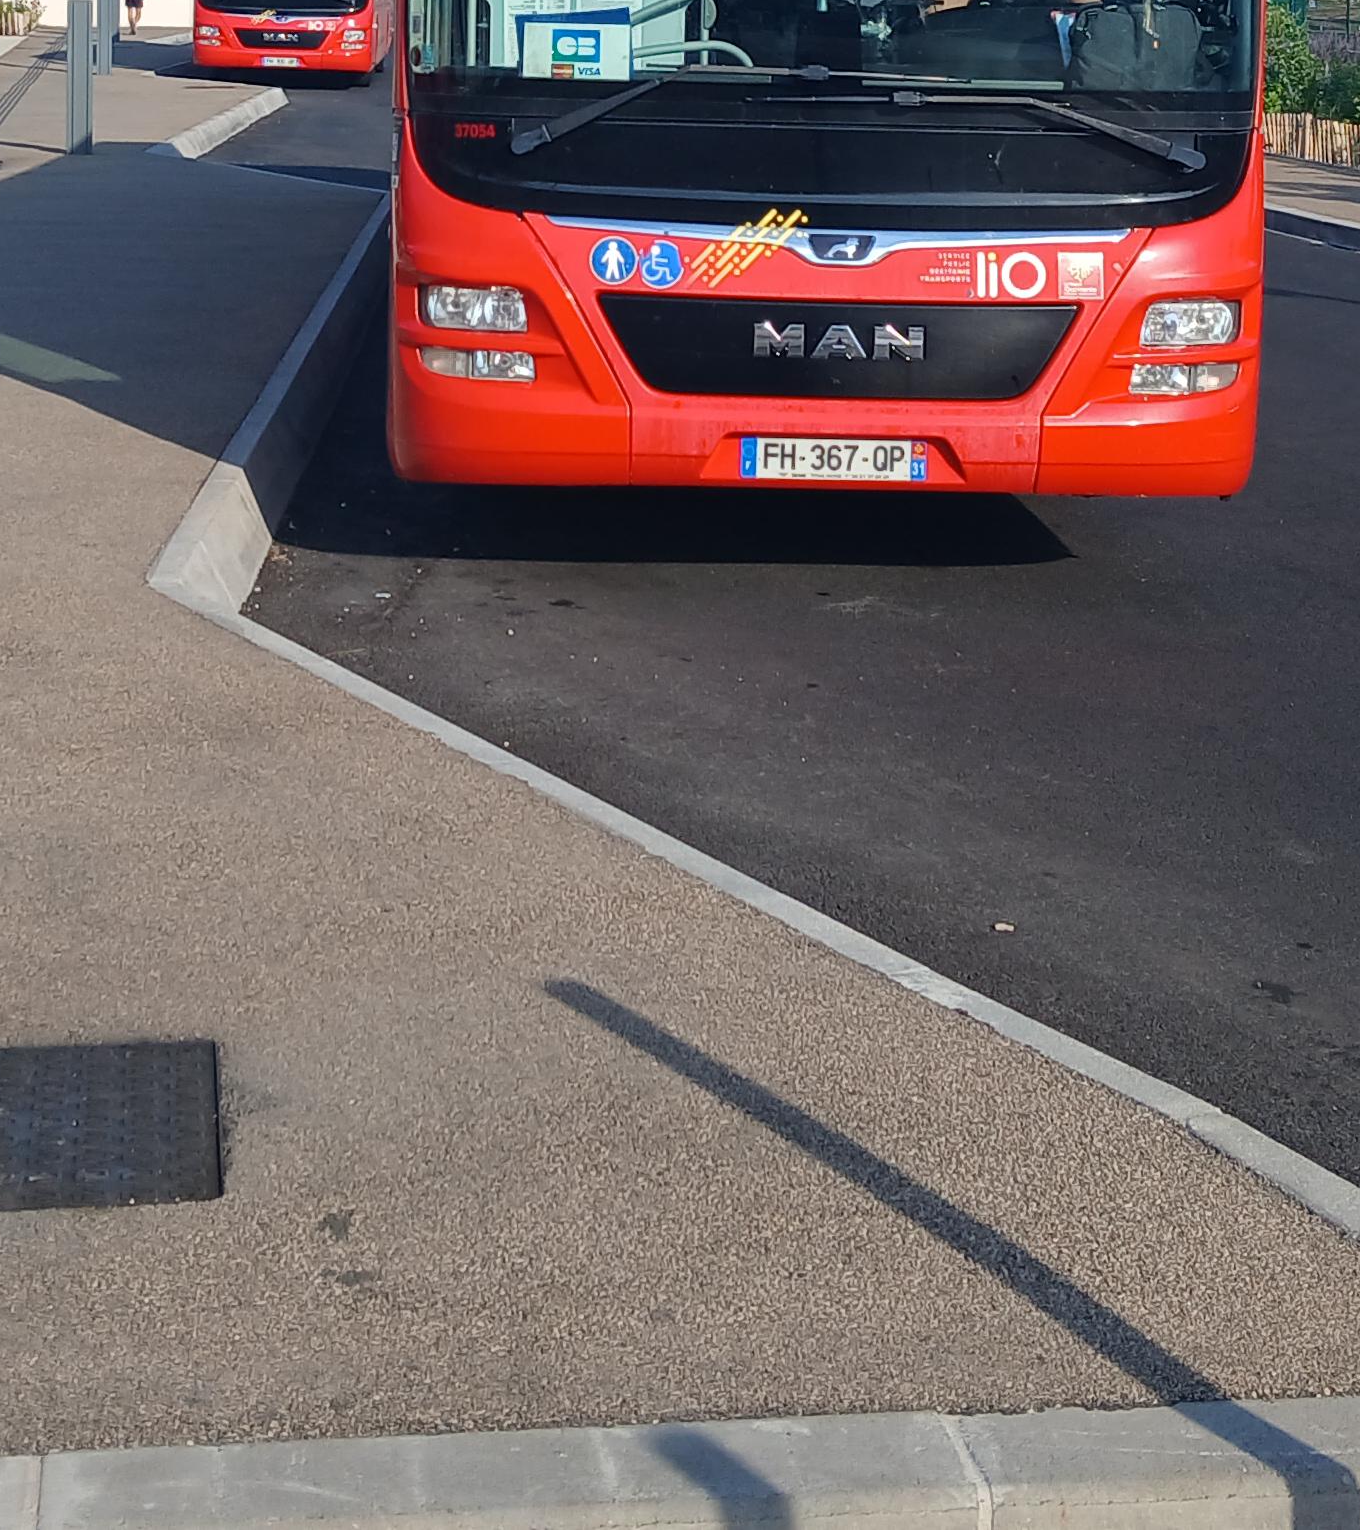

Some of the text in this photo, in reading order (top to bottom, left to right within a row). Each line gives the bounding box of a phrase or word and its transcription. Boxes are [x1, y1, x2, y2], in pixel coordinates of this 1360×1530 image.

[577, 67, 601, 76] VISA
[753, 321, 925, 361] MAN
[762, 443, 905, 472] FH-367-QP
[912, 461, 925, 477] 31
